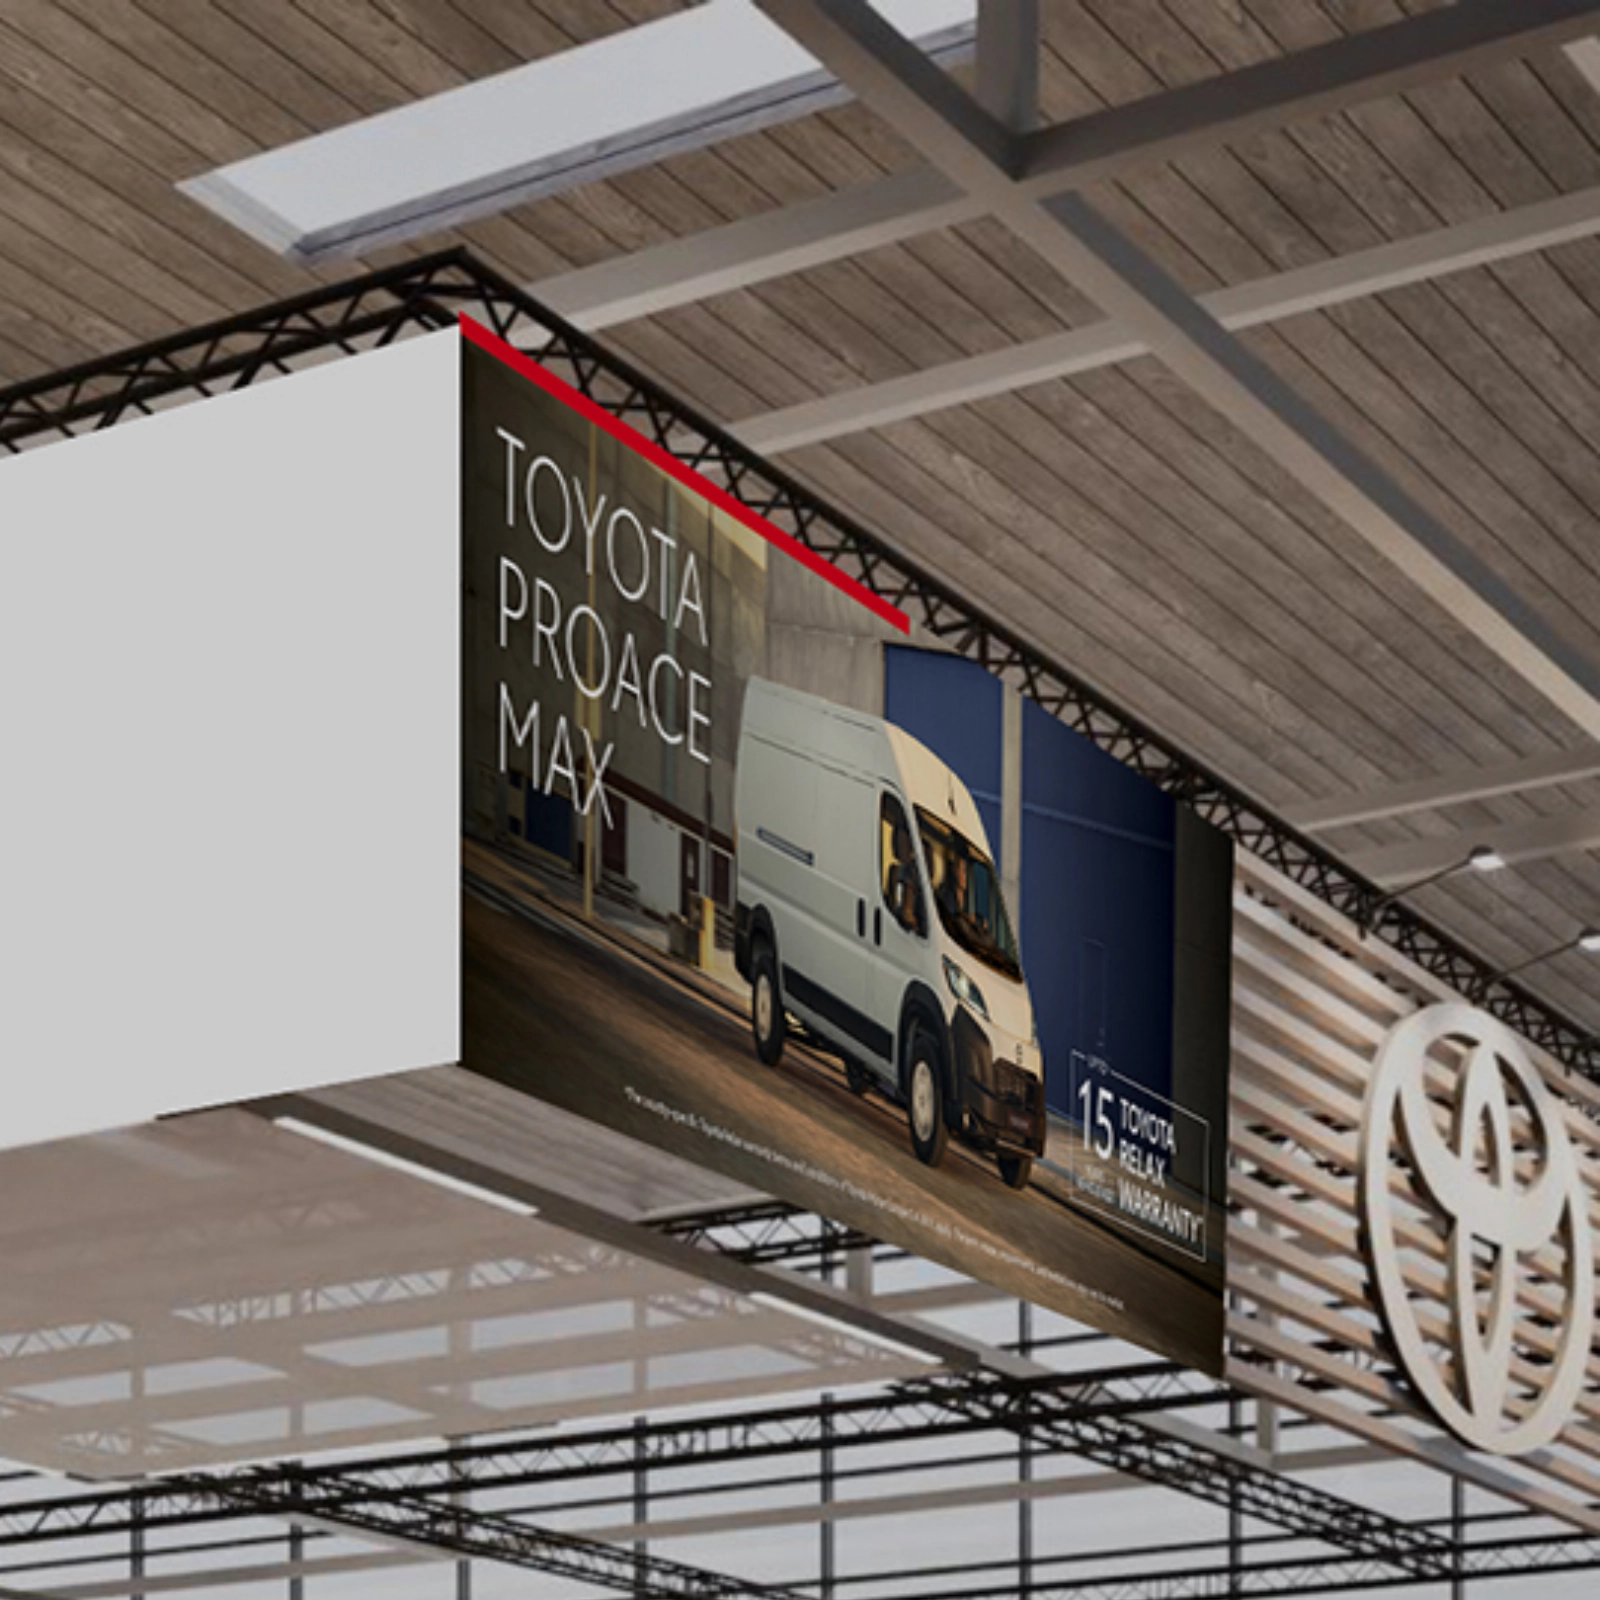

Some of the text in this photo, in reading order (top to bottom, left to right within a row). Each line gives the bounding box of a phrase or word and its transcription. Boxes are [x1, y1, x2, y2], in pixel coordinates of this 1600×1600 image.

[496, 426, 709, 648] TOYOTA
[500, 555, 711, 765] PROACE
[499, 681, 614, 831] MAX
[1077, 1078, 1115, 1161] 15
[1119, 1098, 1177, 1156] TOYOTA
[1119, 1139, 1167, 1189] RELAX
